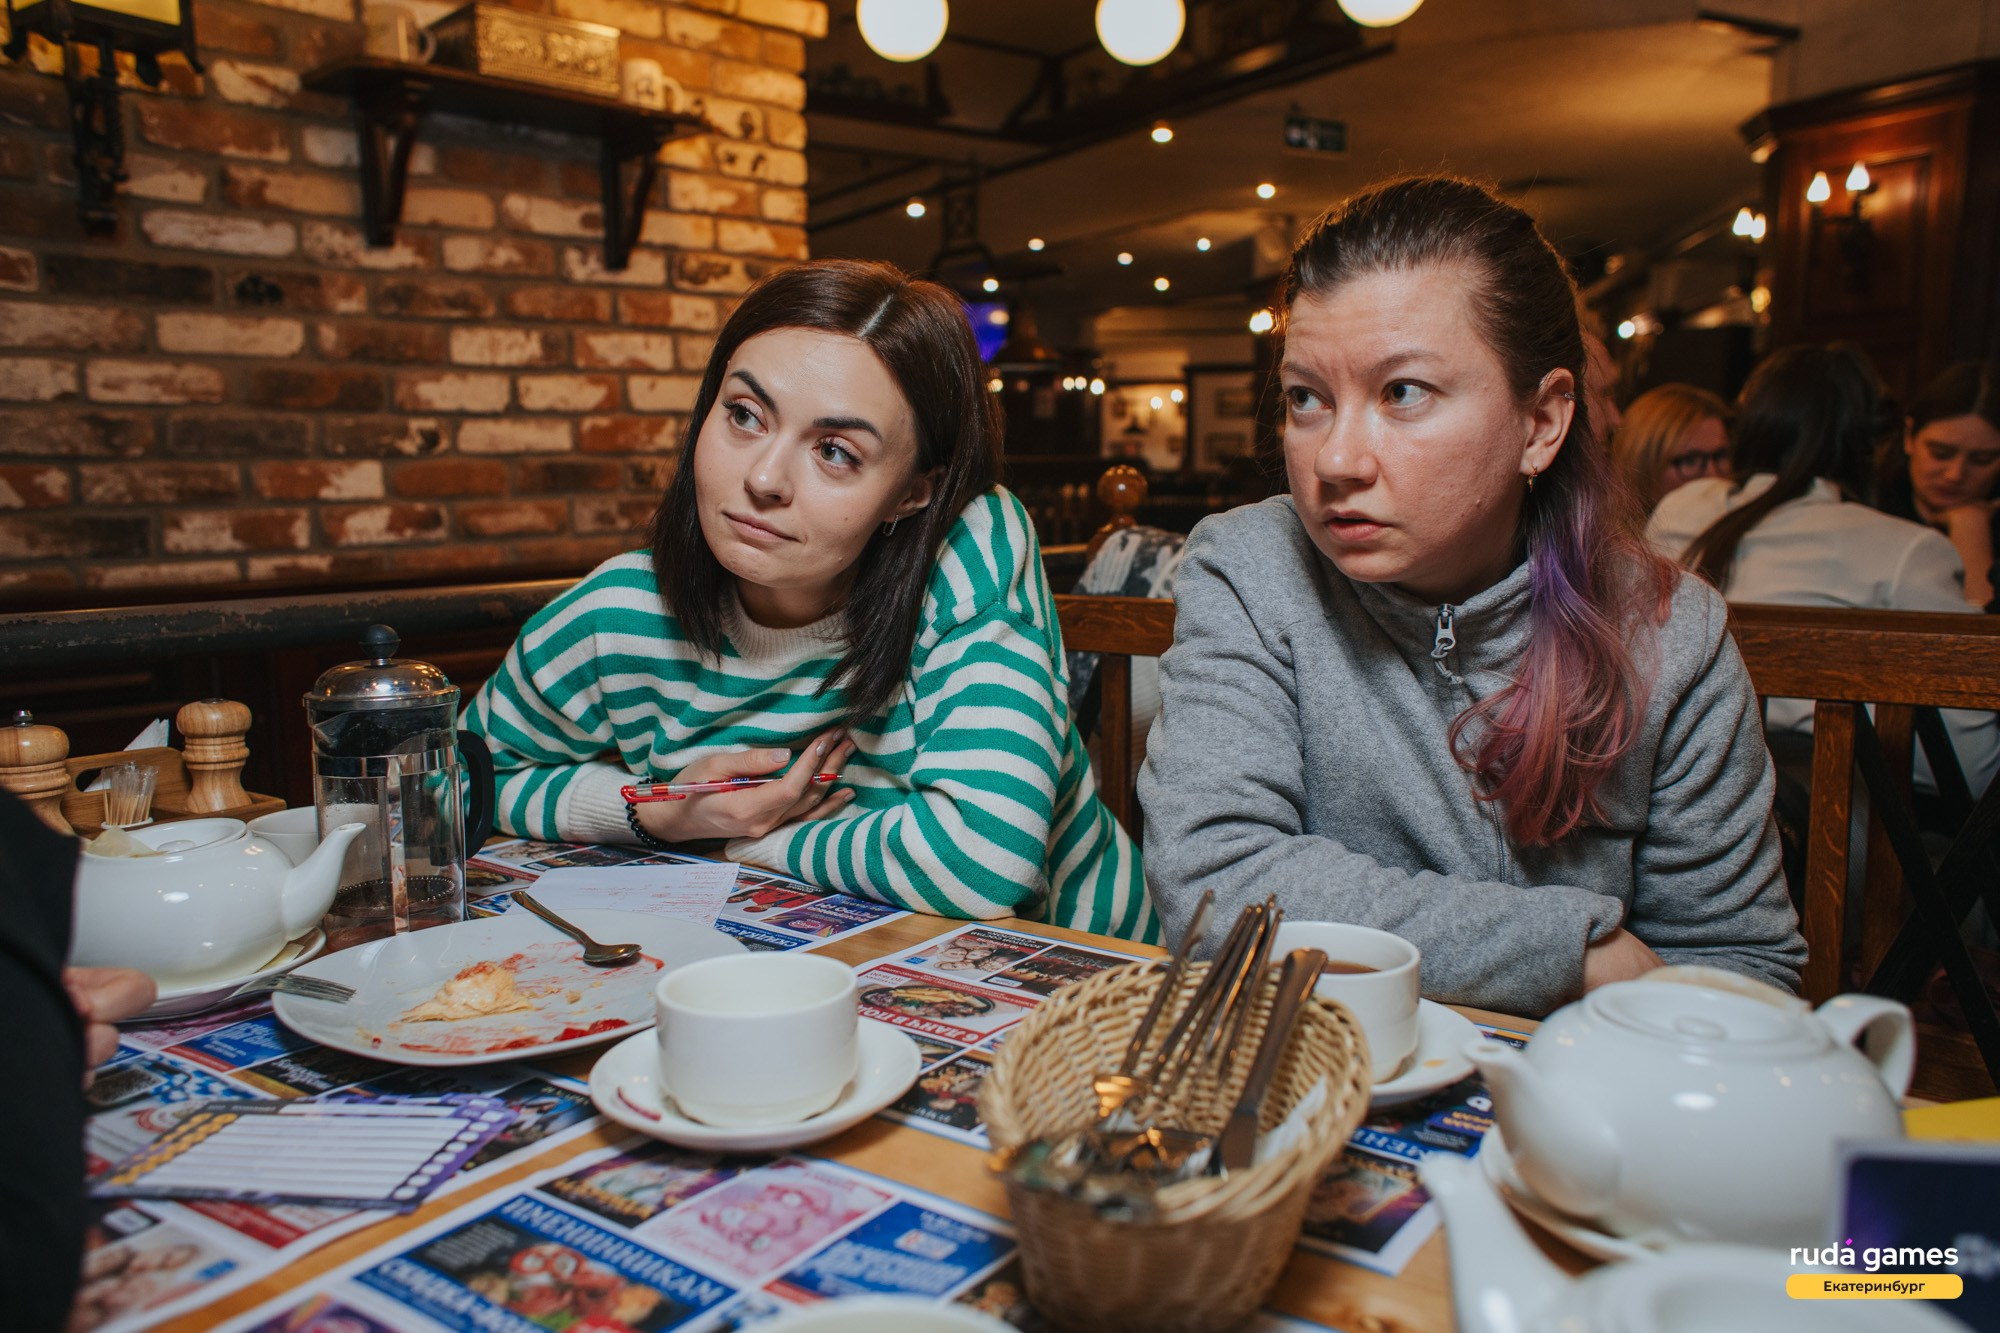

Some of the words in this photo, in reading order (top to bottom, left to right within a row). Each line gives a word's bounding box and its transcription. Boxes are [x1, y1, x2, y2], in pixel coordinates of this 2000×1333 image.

[738, 930, 798, 947] СКИДКА
[892, 1015, 910, 1024] В
[905, 1019, 966, 1038] ЛАНЧ
[500, 1195, 726, 1304] ИМЕНИННИКАМ
